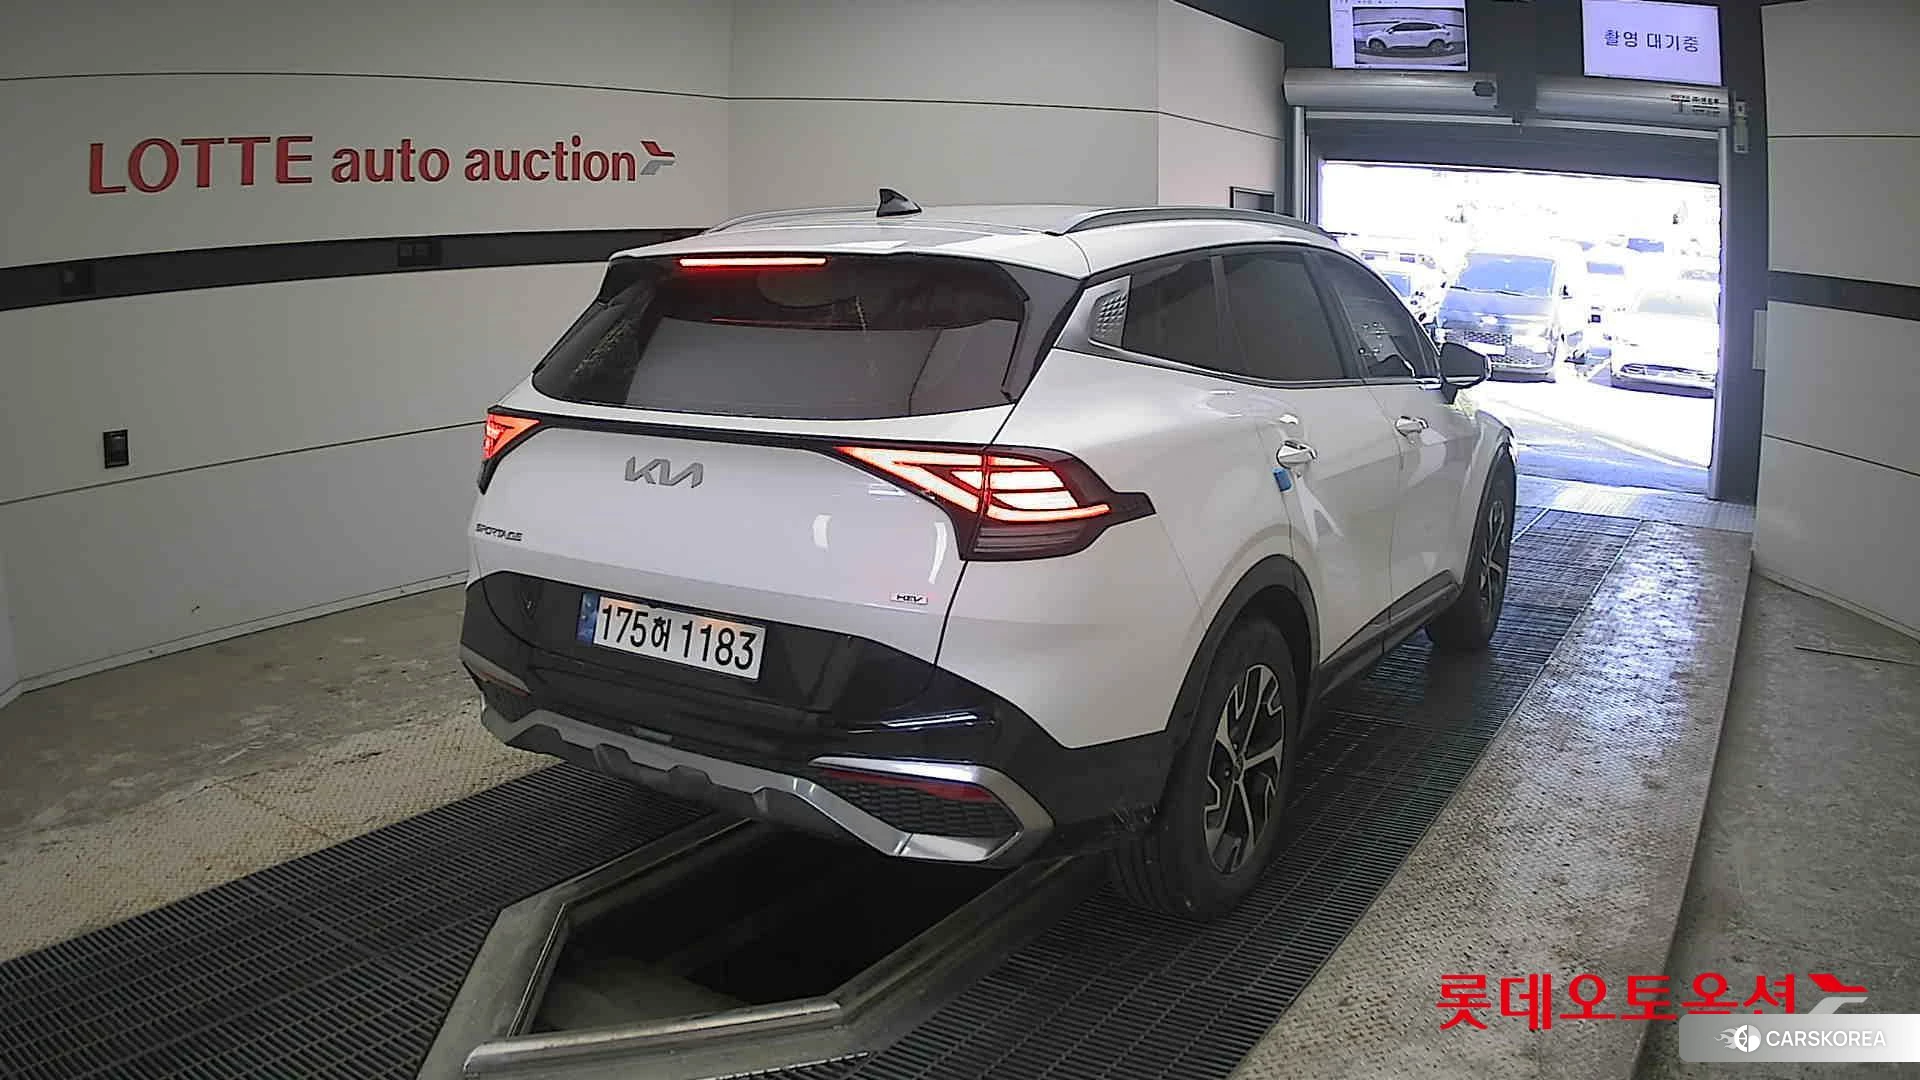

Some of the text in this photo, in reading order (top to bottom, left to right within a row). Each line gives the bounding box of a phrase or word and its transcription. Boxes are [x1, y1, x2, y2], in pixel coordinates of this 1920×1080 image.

[1604, 29, 1699, 53] 촬영 대기중
[88, 135, 637, 194] LOTTE auto auction
[624, 456, 704, 489] KIA
[601, 603, 758, 670] 175허 1183
